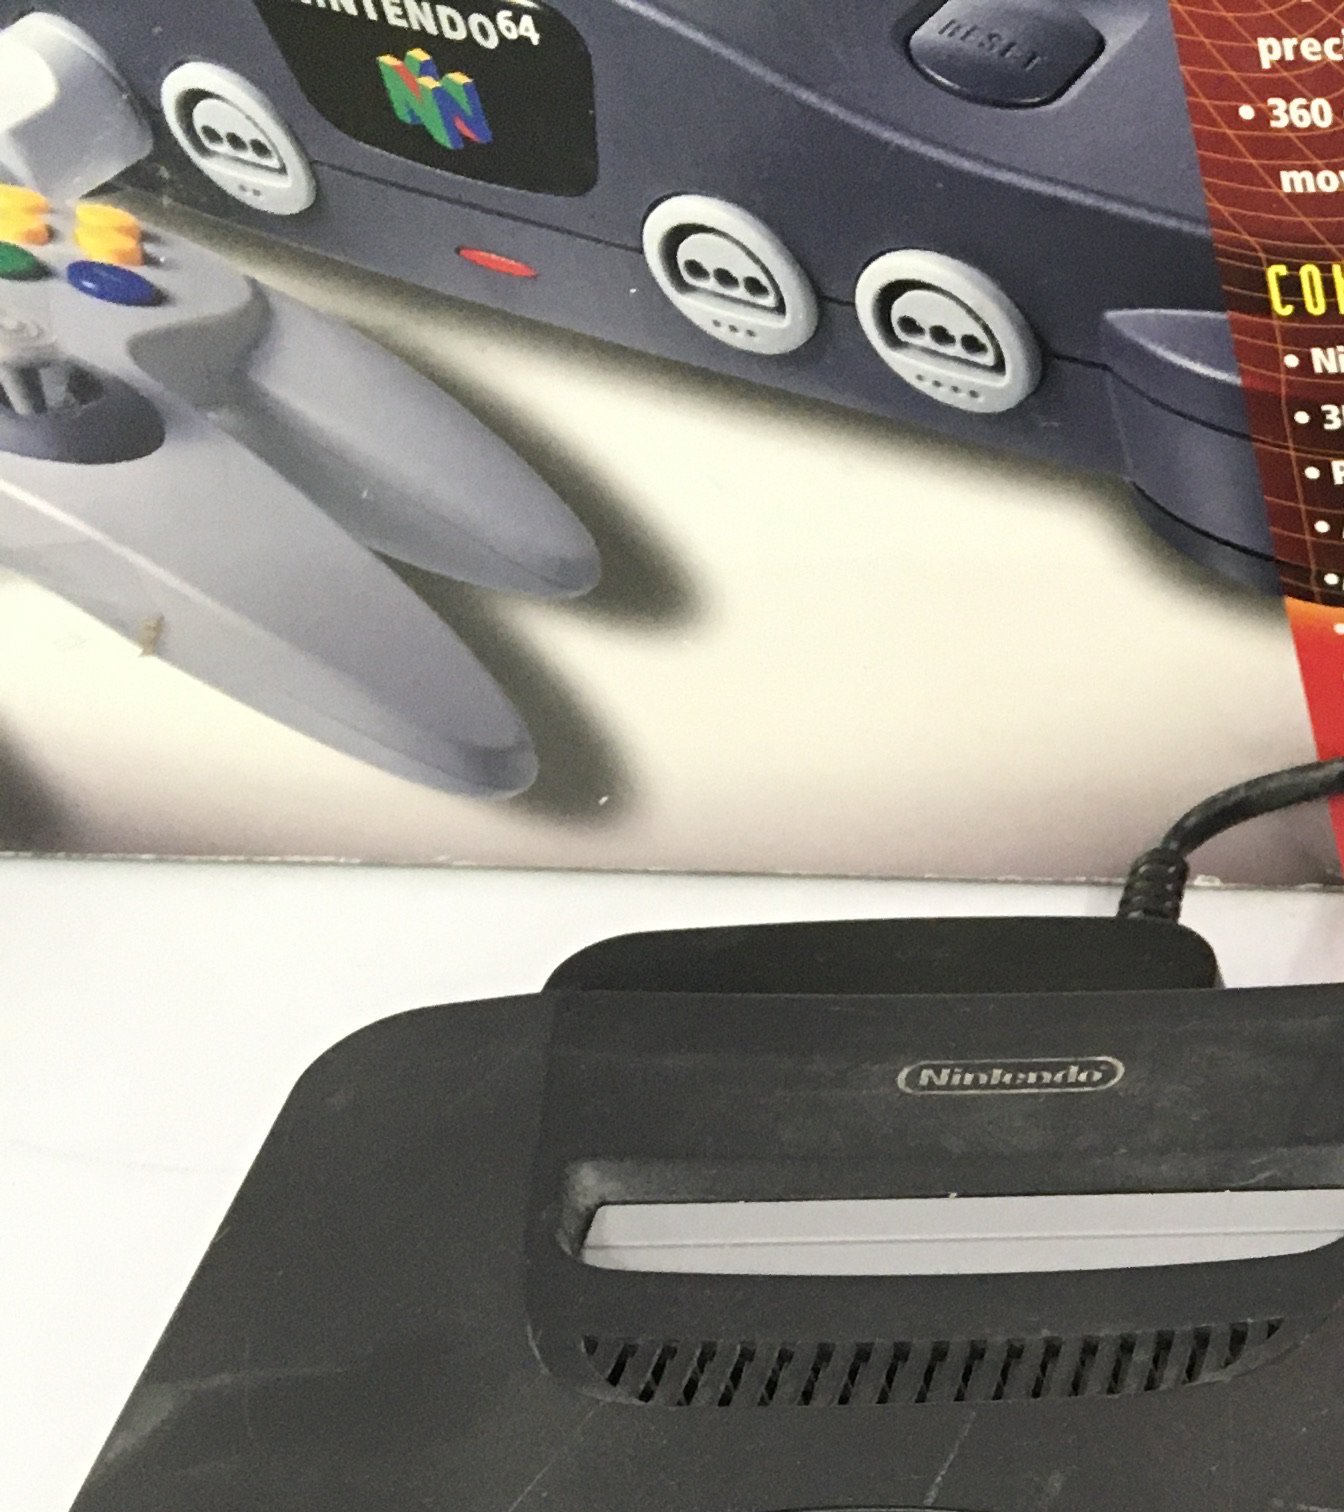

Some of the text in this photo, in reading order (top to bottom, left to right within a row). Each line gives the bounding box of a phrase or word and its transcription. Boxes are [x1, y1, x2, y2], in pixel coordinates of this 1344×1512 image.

[297, 0, 541, 50] TENDO64
[1267, 97, 1333, 129] 360
[918, 1065, 1103, 1087] Nintendo
